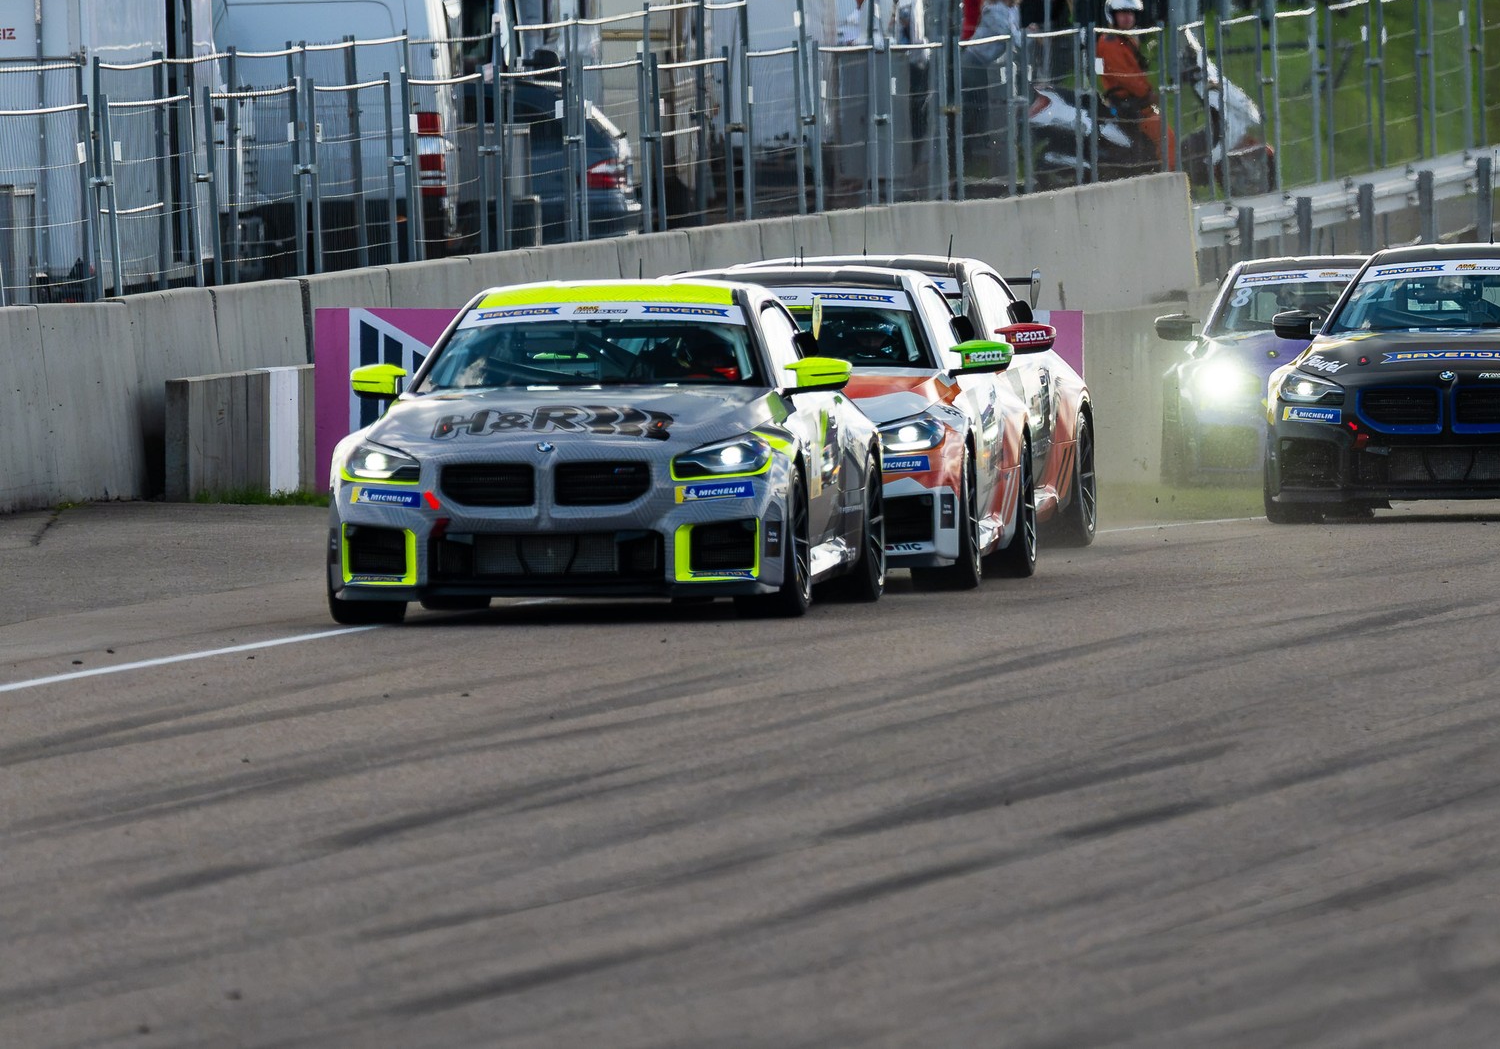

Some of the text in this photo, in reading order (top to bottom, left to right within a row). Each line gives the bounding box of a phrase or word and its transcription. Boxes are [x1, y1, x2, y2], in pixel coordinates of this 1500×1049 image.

[1381, 265, 1443, 275] RAVENOL
[1230, 287, 1253, 307] 8
[483, 307, 552, 319] RAVENOL
[648, 307, 722, 316] RAVENOL
[1303, 354, 1349, 373] Teufel
[1298, 411, 1334, 420] MICHELIN
[431, 405, 590, 441] H&R
[698, 486, 746, 497] MICHELIN
[370, 493, 413, 503] MICHELIN
